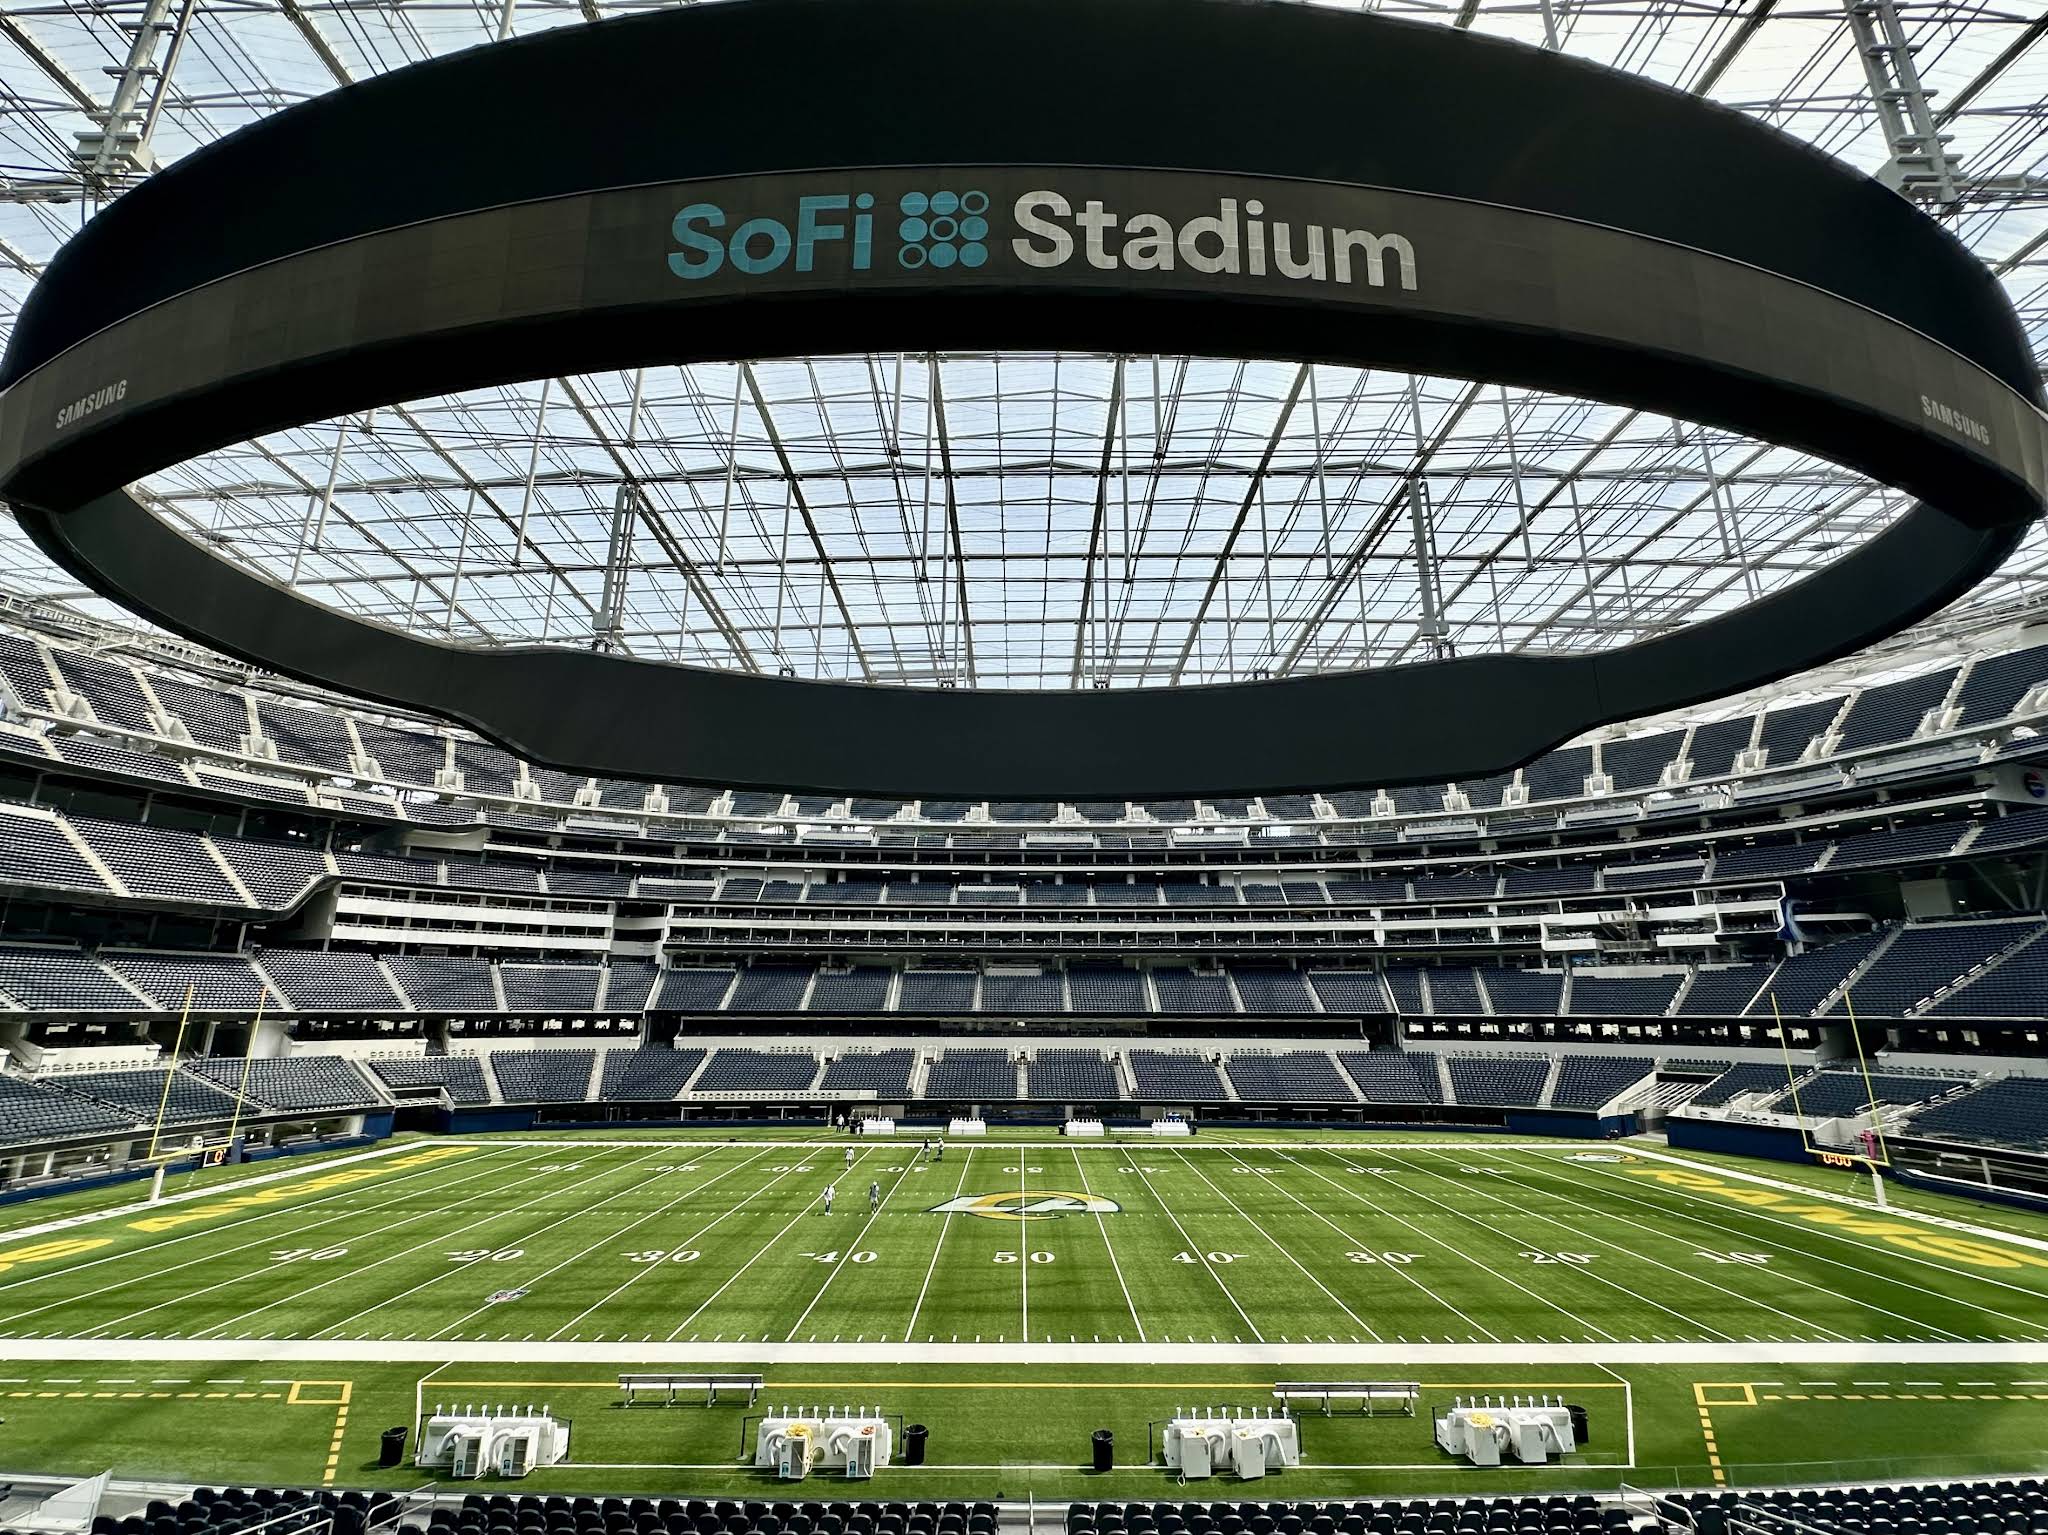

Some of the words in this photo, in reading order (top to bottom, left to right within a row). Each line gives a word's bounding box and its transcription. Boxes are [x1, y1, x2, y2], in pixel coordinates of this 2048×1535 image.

[667, 192, 875, 280] SoFi
[1012, 190, 1417, 291] Stadium
[56, 380, 127, 429] SAMSUNG
[1921, 395, 1990, 445] SAMSUNG
[1624, 1169, 2048, 1268] RAMS
[631, 1250, 700, 1263] 30
[812, 1251, 878, 1263] 40
[992, 1251, 1055, 1264] 50
[1172, 1251, 1234, 1264] 40
[1345, 1251, 1412, 1264] 30
